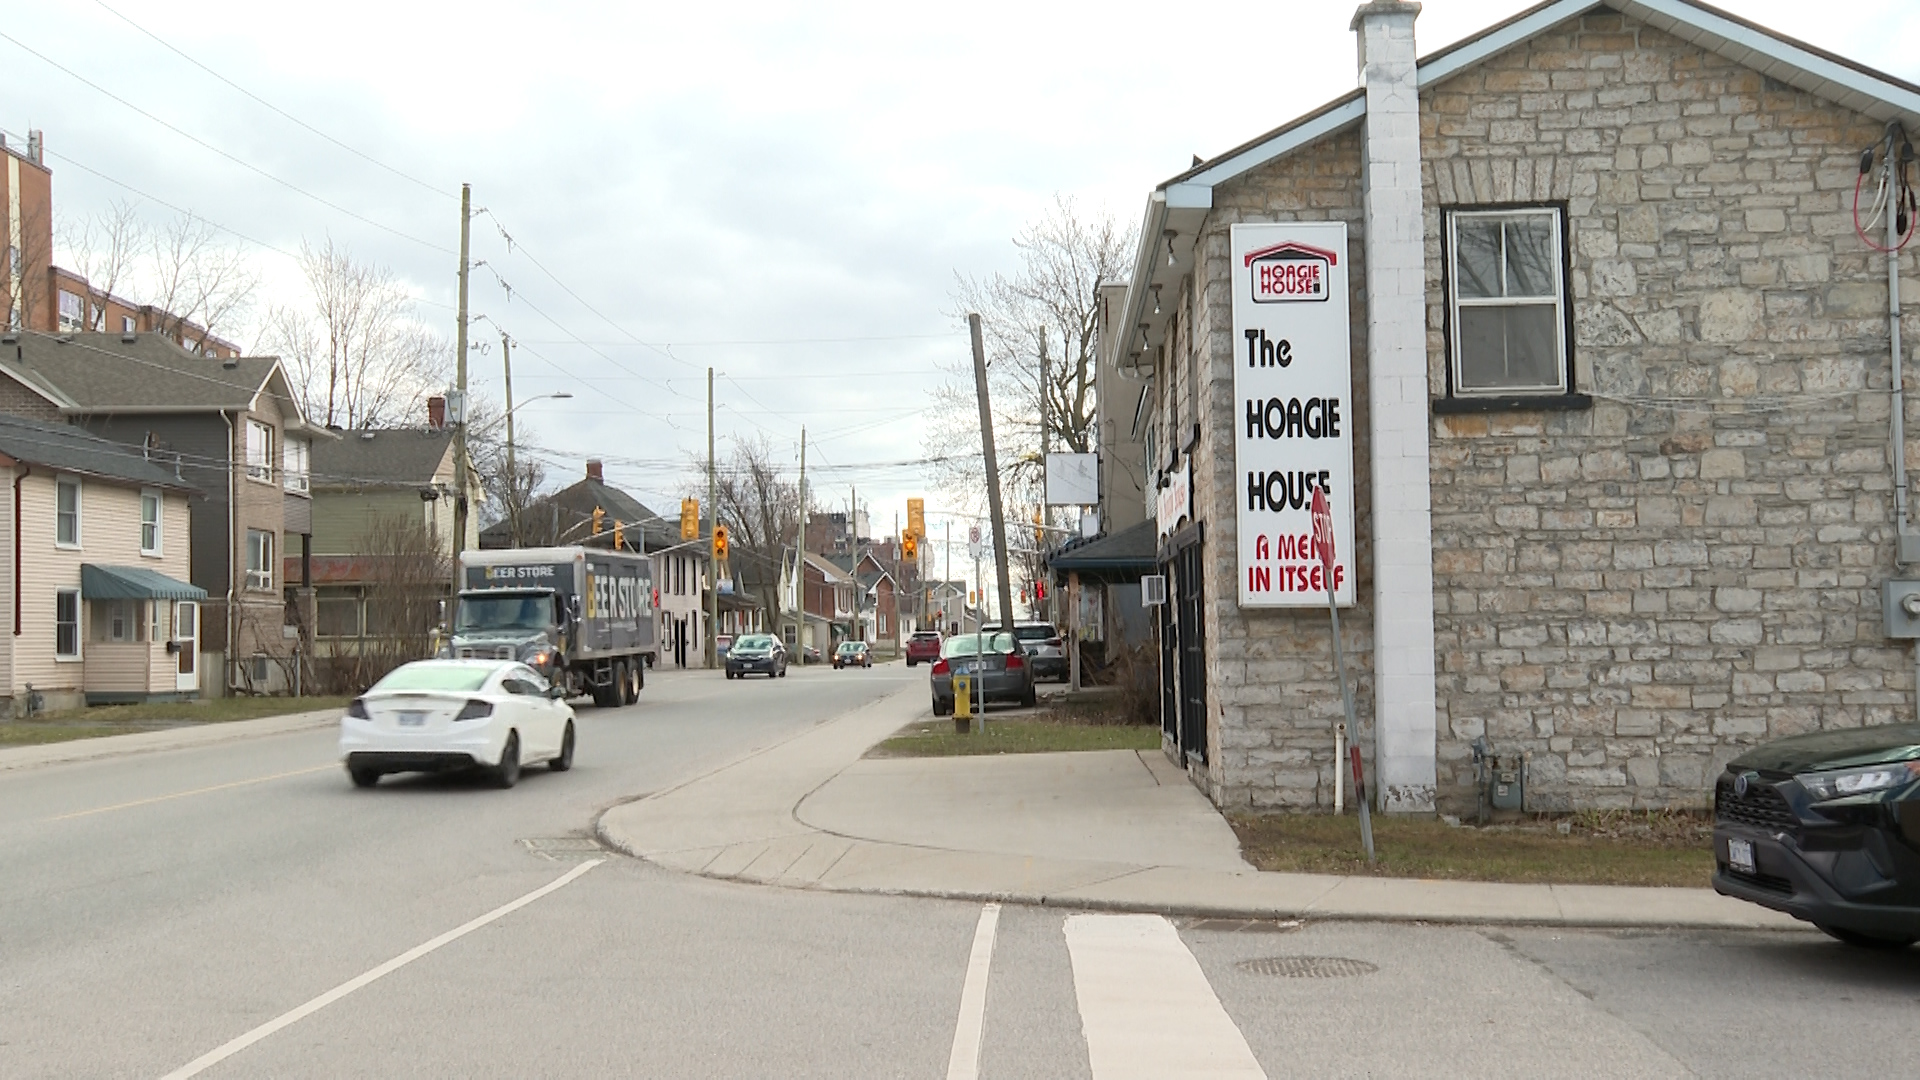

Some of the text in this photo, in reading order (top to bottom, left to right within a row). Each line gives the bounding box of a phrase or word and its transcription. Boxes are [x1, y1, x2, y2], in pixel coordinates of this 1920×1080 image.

[1260, 265, 1320, 279] HOAGIE
[1261, 280, 1313, 294] HOUSE
[1244, 328, 1293, 368] The
[1246, 397, 1341, 440] HOAGIE
[1247, 470, 1331, 513] HOUSE
[1312, 511, 1334, 545] STOP
[1256, 533, 1270, 560] A
[485, 565, 556, 580] BEER STORE
[1248, 565, 1271, 592] IN
[586, 574, 618, 619] BEER
